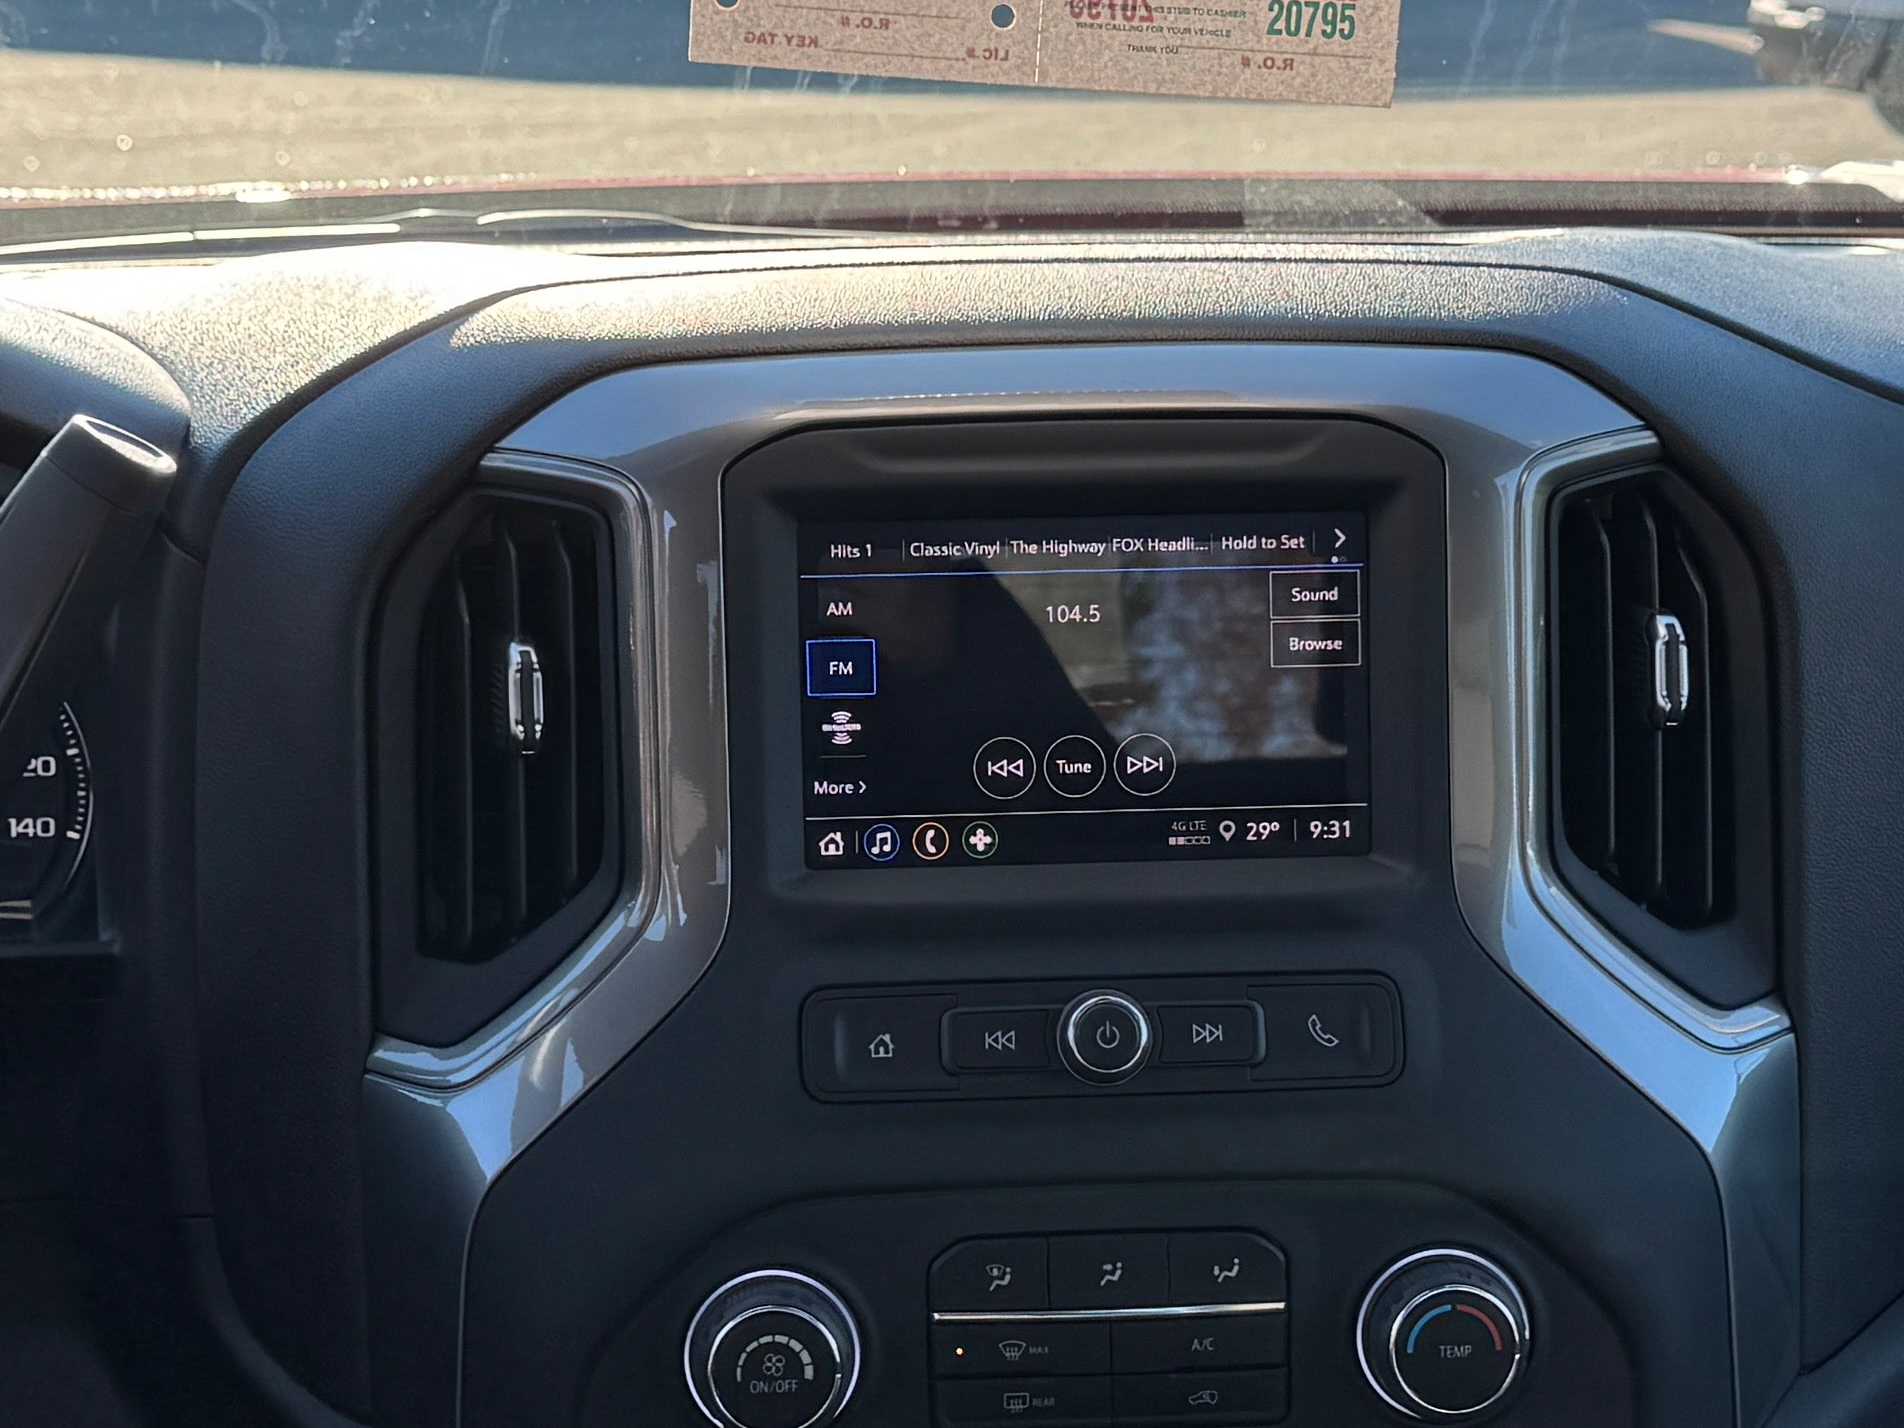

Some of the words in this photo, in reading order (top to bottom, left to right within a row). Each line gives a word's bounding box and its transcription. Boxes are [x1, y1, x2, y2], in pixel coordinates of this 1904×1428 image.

[909, 541, 962, 558] Classic
[963, 540, 1001, 560] Vinyl
[1010, 540, 1038, 555] The
[1042, 538, 1106, 558] Highway
[1112, 537, 1144, 553] FOX
[1147, 536, 1209, 553] Headli...
[1221, 535, 1257, 551] Hold
[1261, 537, 1277, 550] to
[1280, 534, 1306, 551] Set
[830, 543, 861, 559] Hits
[864, 543, 873, 558] 1
[1291, 586, 1340, 603] Sound
[826, 601, 854, 617] AM
[1045, 604, 1102, 624] 104.5
[1289, 637, 1344, 652] Browse
[828, 661, 854, 676] FM
[1056, 759, 1093, 774] Tune
[813, 780, 855, 795] More
[7, 817, 58, 839] 140
[1171, 820, 1187, 832] 4G
[1189, 819, 1209, 832] LTE
[1245, 820, 1281, 841] 29°
[1309, 819, 1351, 840] 9:31
[1029, 1345, 1050, 1355] MAX
[1191, 1337, 1215, 1351] A/C
[1439, 1345, 1473, 1359] TEMP
[749, 1379, 799, 1394] ON/OFF
[1032, 1397, 1056, 1407] REAR
